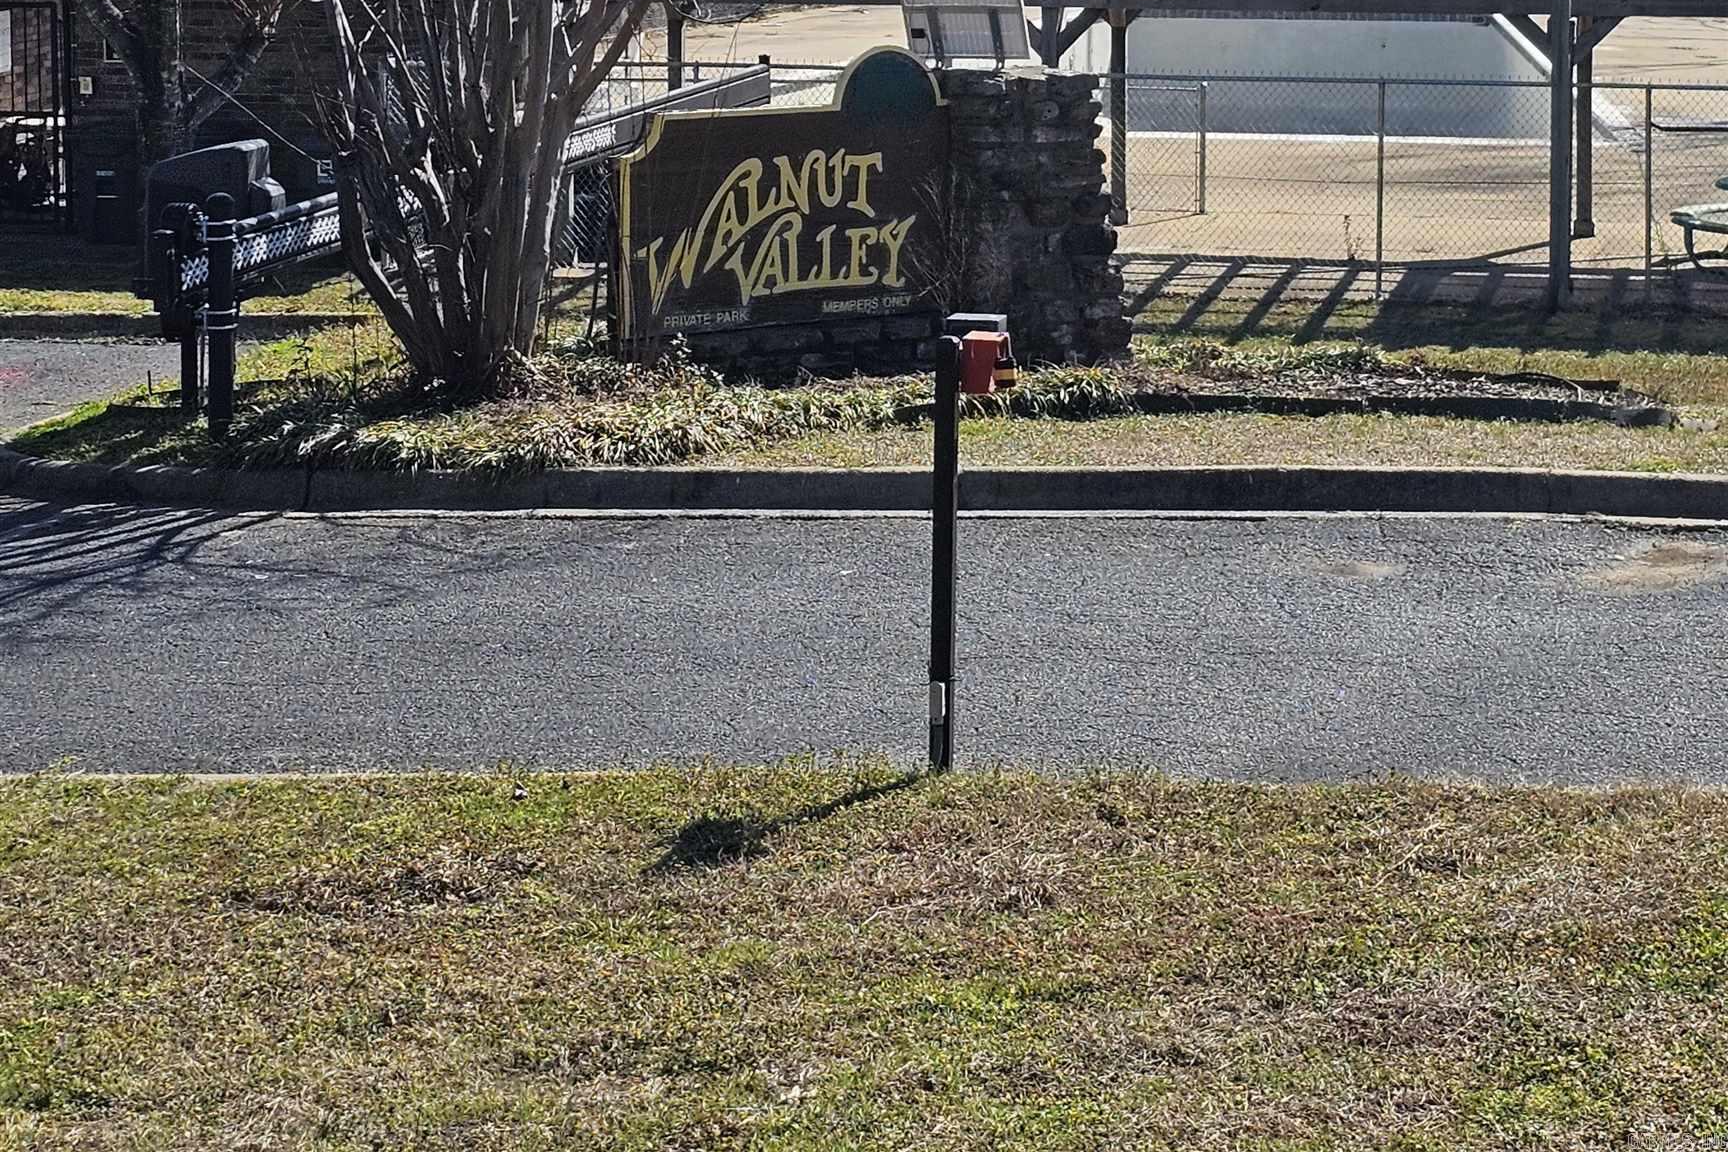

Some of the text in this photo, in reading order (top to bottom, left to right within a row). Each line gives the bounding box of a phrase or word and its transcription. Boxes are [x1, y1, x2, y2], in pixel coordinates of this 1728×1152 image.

[634, 148, 883, 315] WALNUT
[724, 211, 916, 306] VALLEY
[663, 310, 749, 329] PRIVATE PARK
[883, 295, 912, 308] ONLY
